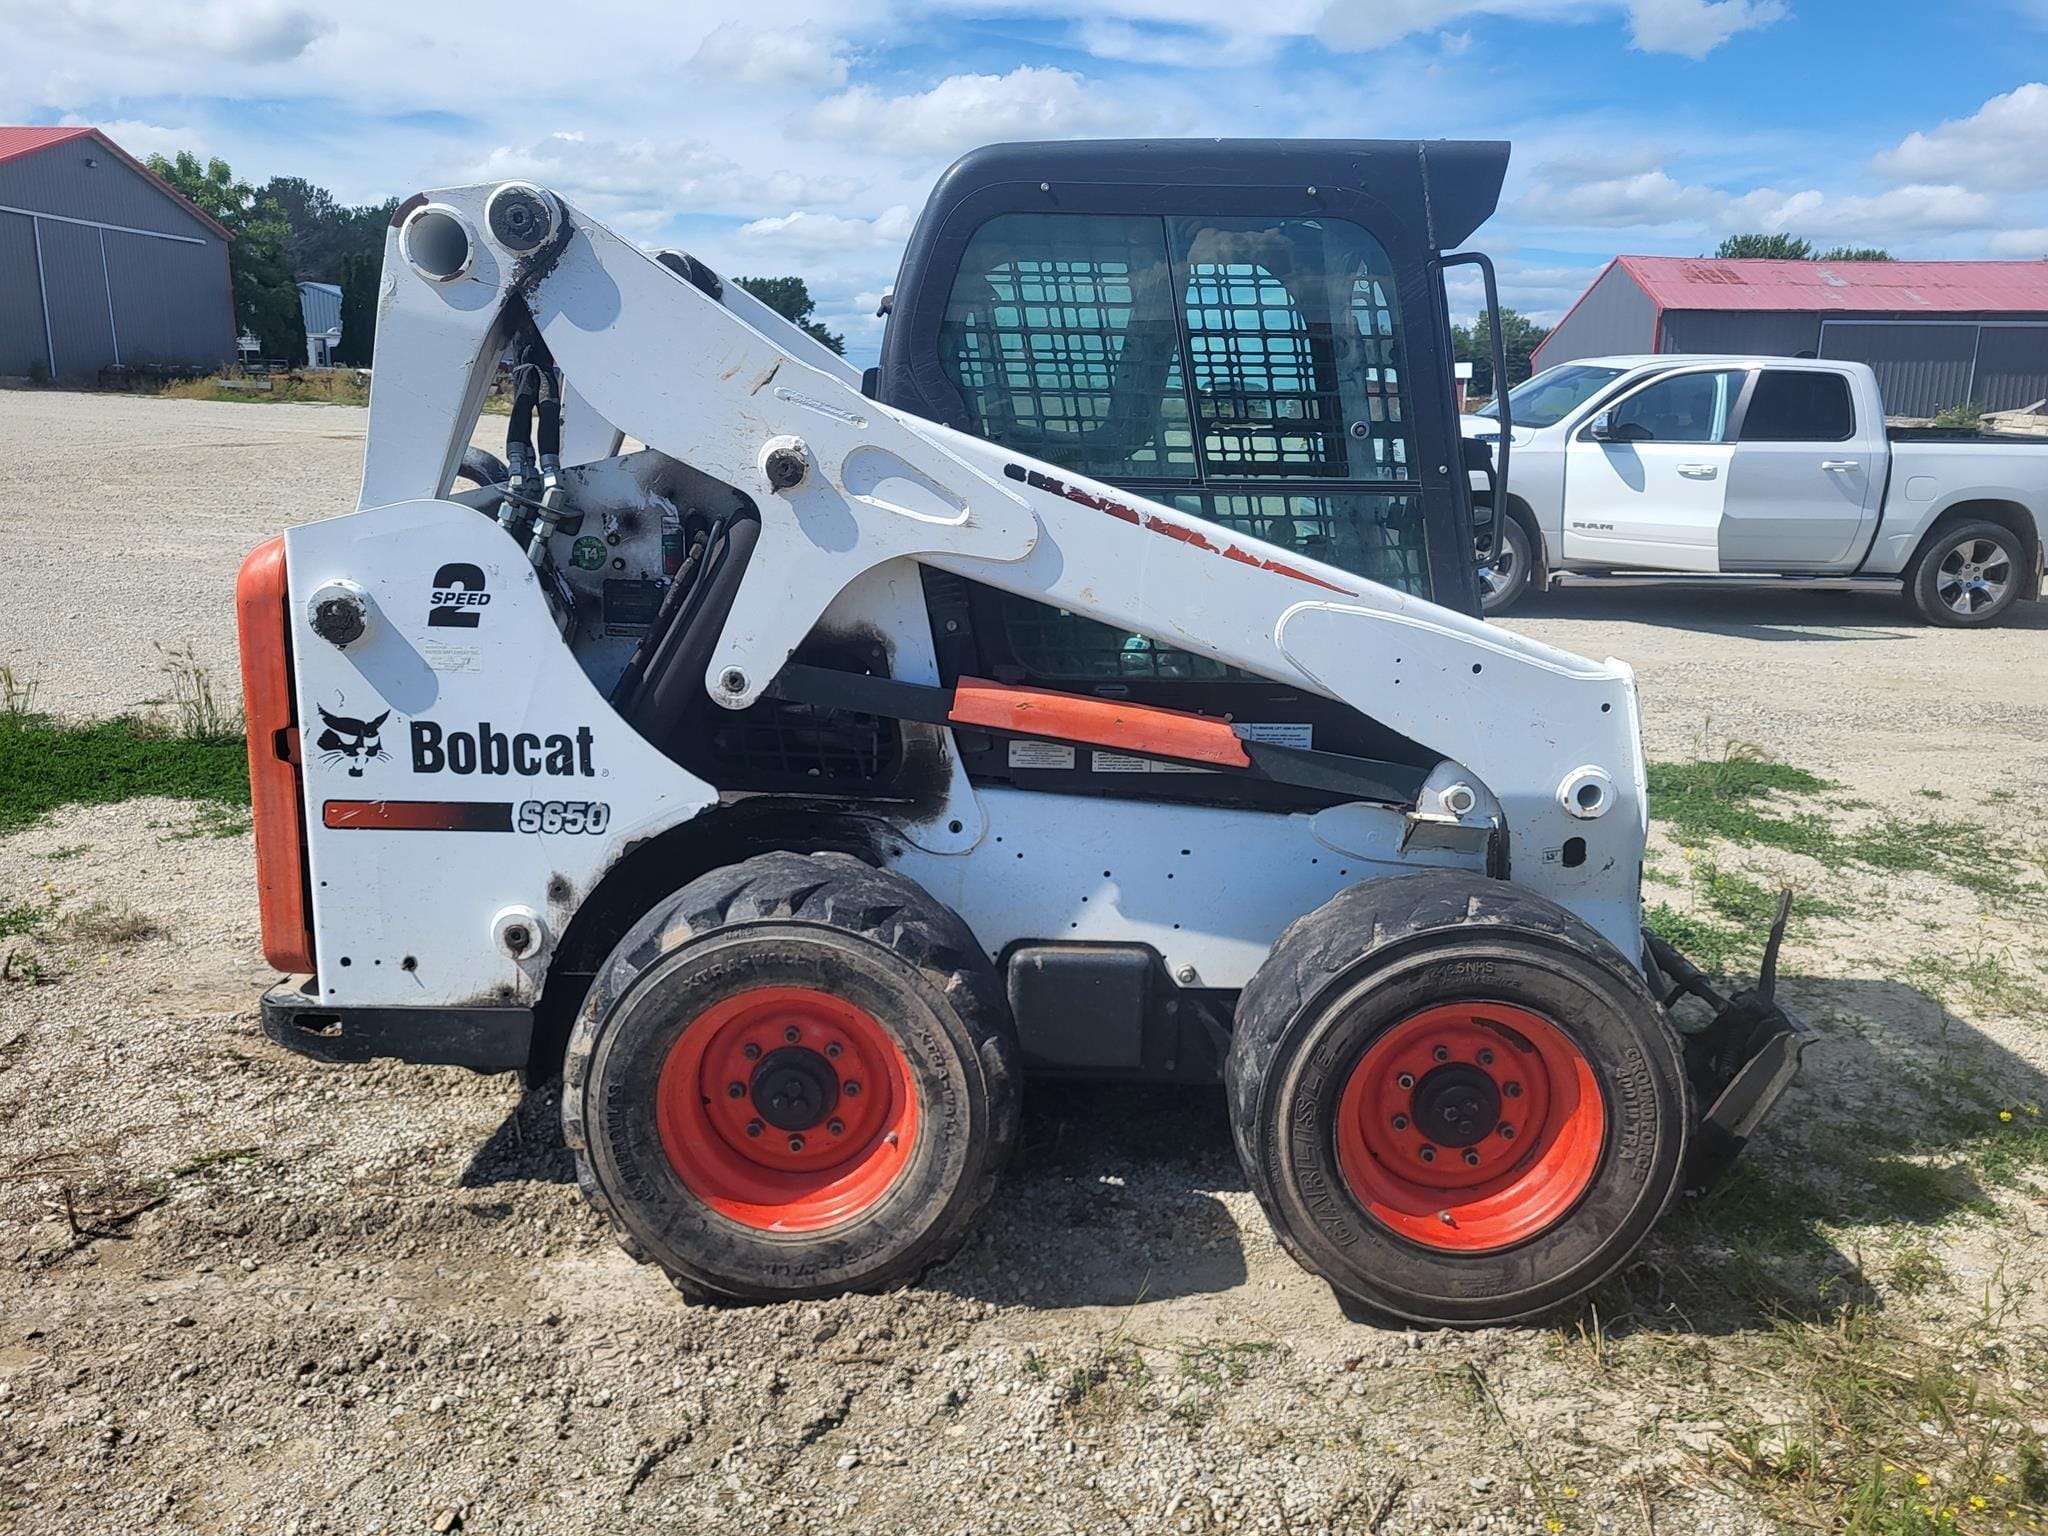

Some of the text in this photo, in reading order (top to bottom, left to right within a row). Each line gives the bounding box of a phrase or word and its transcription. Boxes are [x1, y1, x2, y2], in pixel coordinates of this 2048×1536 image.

[1572, 522, 1613, 530] RAM
[582, 547, 599, 560] T4
[428, 563, 487, 628] 2
[430, 591, 491, 606] SPEED
[411, 721, 595, 777] Bobcat
[518, 801, 609, 835] S650
